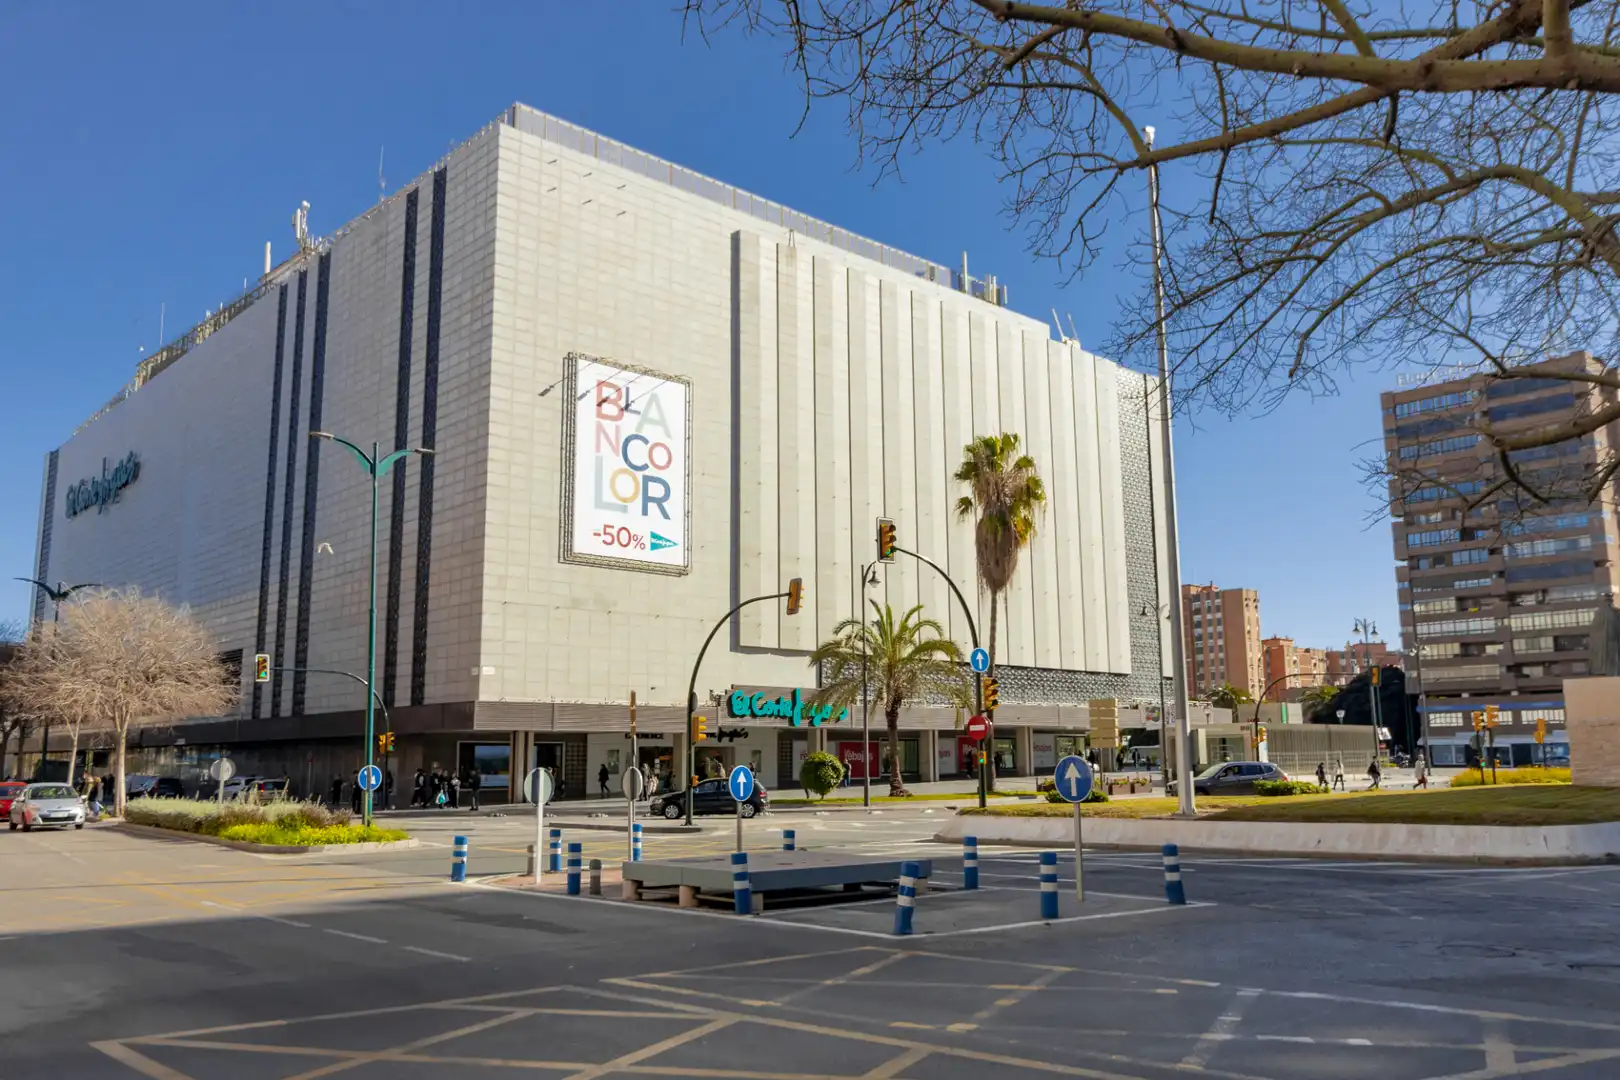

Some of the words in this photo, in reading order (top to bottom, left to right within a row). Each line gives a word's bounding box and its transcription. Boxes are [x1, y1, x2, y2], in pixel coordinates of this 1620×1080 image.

[595, 379, 674, 439] BLA
[594, 421, 673, 472] NCO
[593, 454, 671, 521] LOR
[592, 524, 646, 550] -50%
[728, 689, 751, 717] El
[751, 691, 793, 718] Corte
